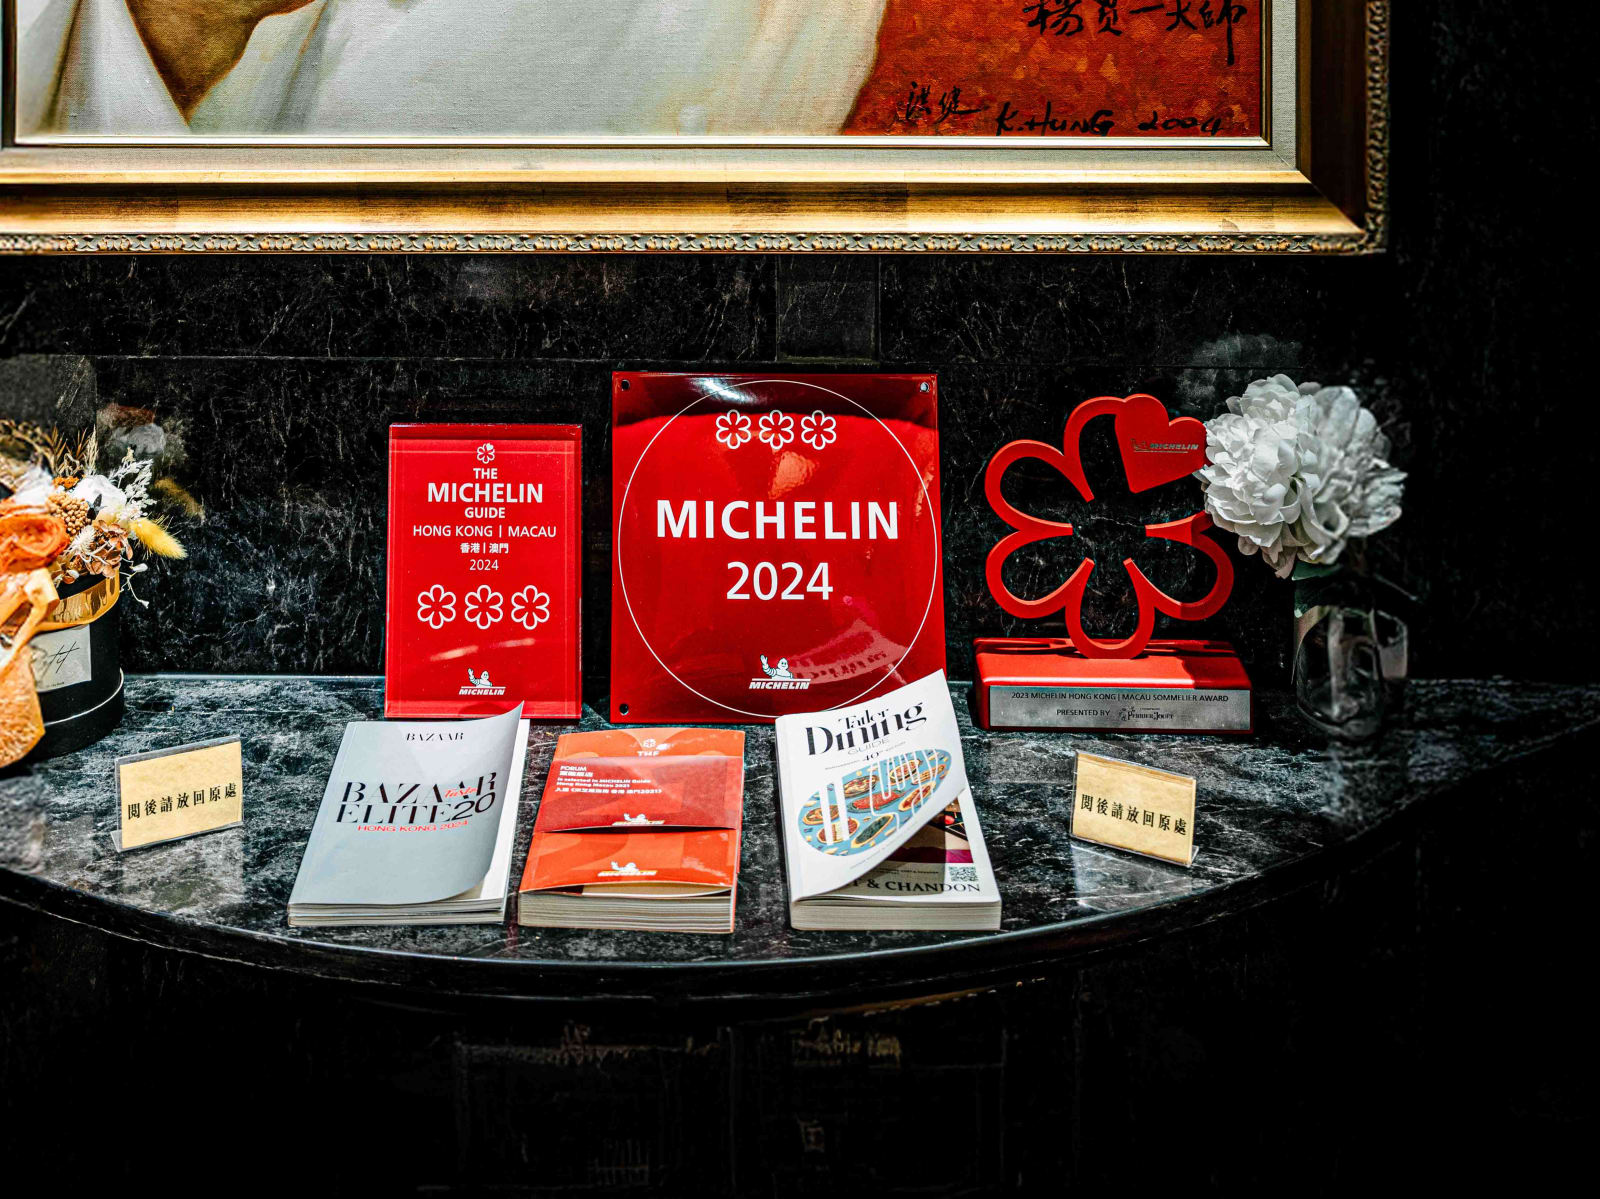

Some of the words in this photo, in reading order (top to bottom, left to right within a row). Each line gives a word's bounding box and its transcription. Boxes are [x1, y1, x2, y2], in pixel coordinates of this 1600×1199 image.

[473, 467, 498, 479] THE
[427, 483, 543, 503] MICHELIN
[465, 507, 506, 519] GUIDE
[657, 500, 898, 540] MICHELIN
[413, 525, 451, 537] HONG
[456, 526, 493, 537] KONG
[508, 526, 557, 537] MACAU
[469, 559, 499, 571] 2024
[726, 561, 833, 600] 2024
[749, 682, 810, 690] MICHELIN
[805, 702, 927, 755] Dining
[406, 732, 464, 741] BAZAAR
[342, 772, 496, 804] BAZAAR
[440, 820, 468, 830] 2024
[885, 881, 980, 893] CHANDON
